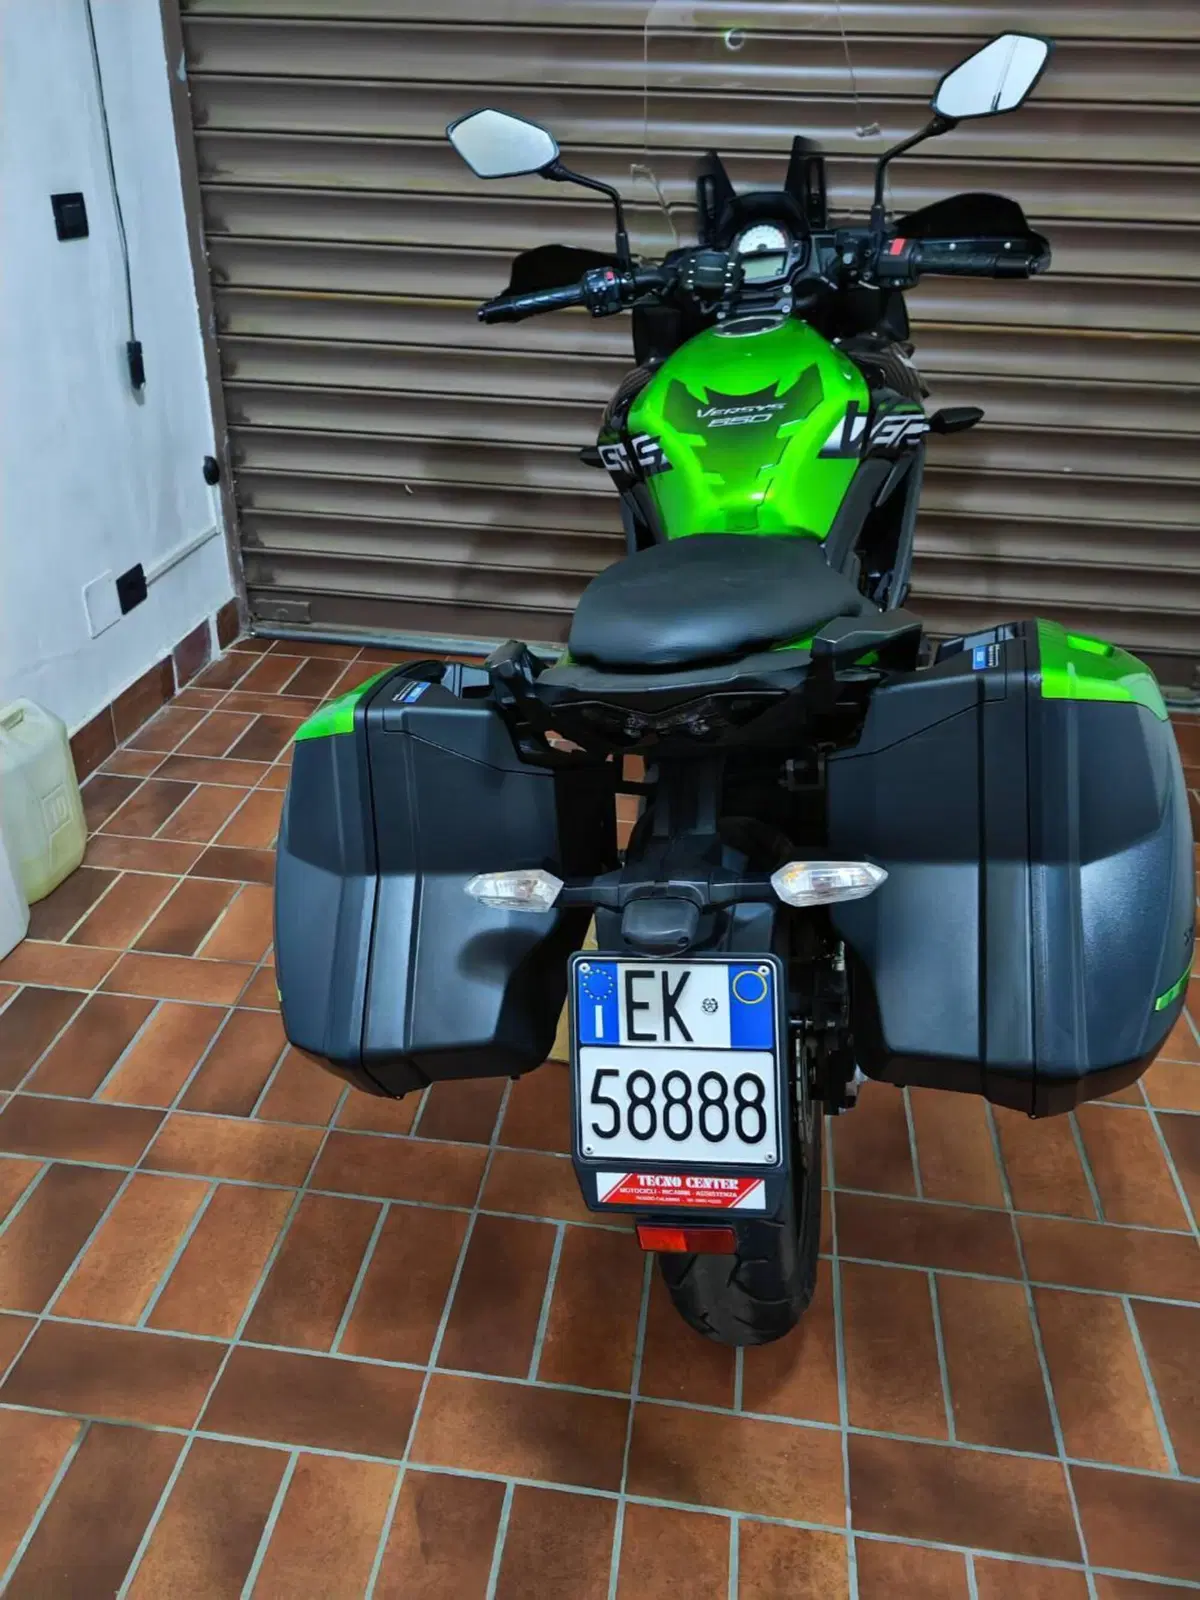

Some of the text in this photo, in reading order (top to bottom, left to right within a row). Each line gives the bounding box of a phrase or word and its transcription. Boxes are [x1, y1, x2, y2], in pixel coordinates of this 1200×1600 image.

[708, 413, 773, 427] 650
[594, 1005, 604, 1038] I
[625, 970, 694, 1042] EK
[590, 1069, 767, 1144] 58888
[637, 1174, 739, 1189] TECNO CENTER
